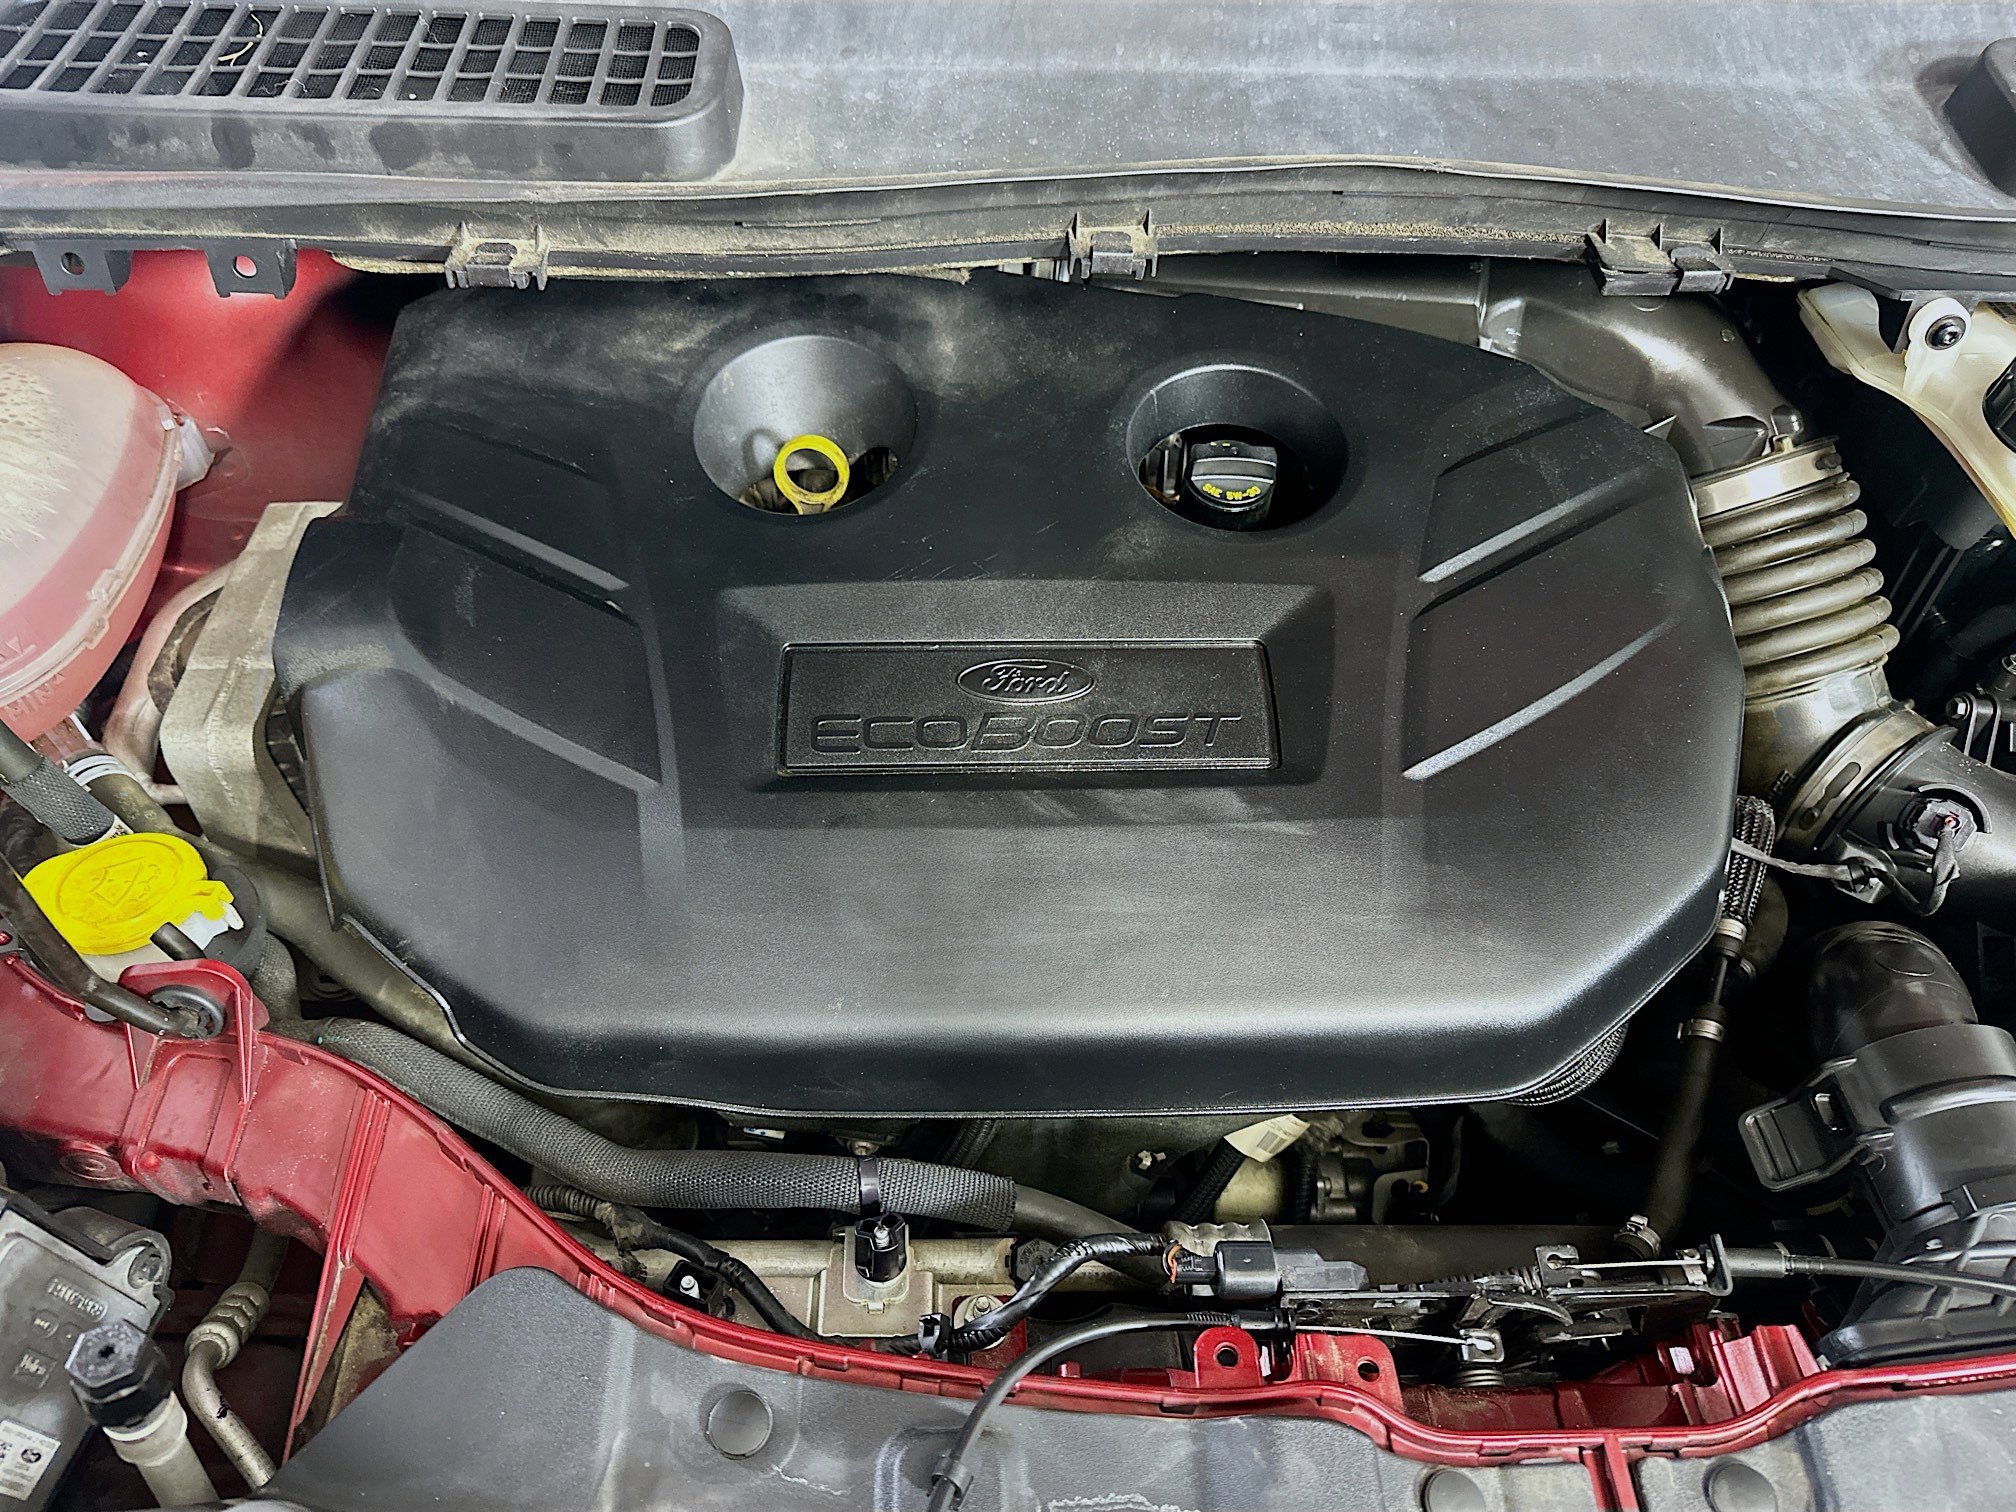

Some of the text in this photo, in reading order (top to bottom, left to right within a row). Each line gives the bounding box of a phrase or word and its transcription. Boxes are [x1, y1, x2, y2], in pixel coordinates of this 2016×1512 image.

[1202, 483, 1223, 498] SAE
[981, 663, 1070, 694] Ford
[810, 711, 1242, 754] ECOBOOST
